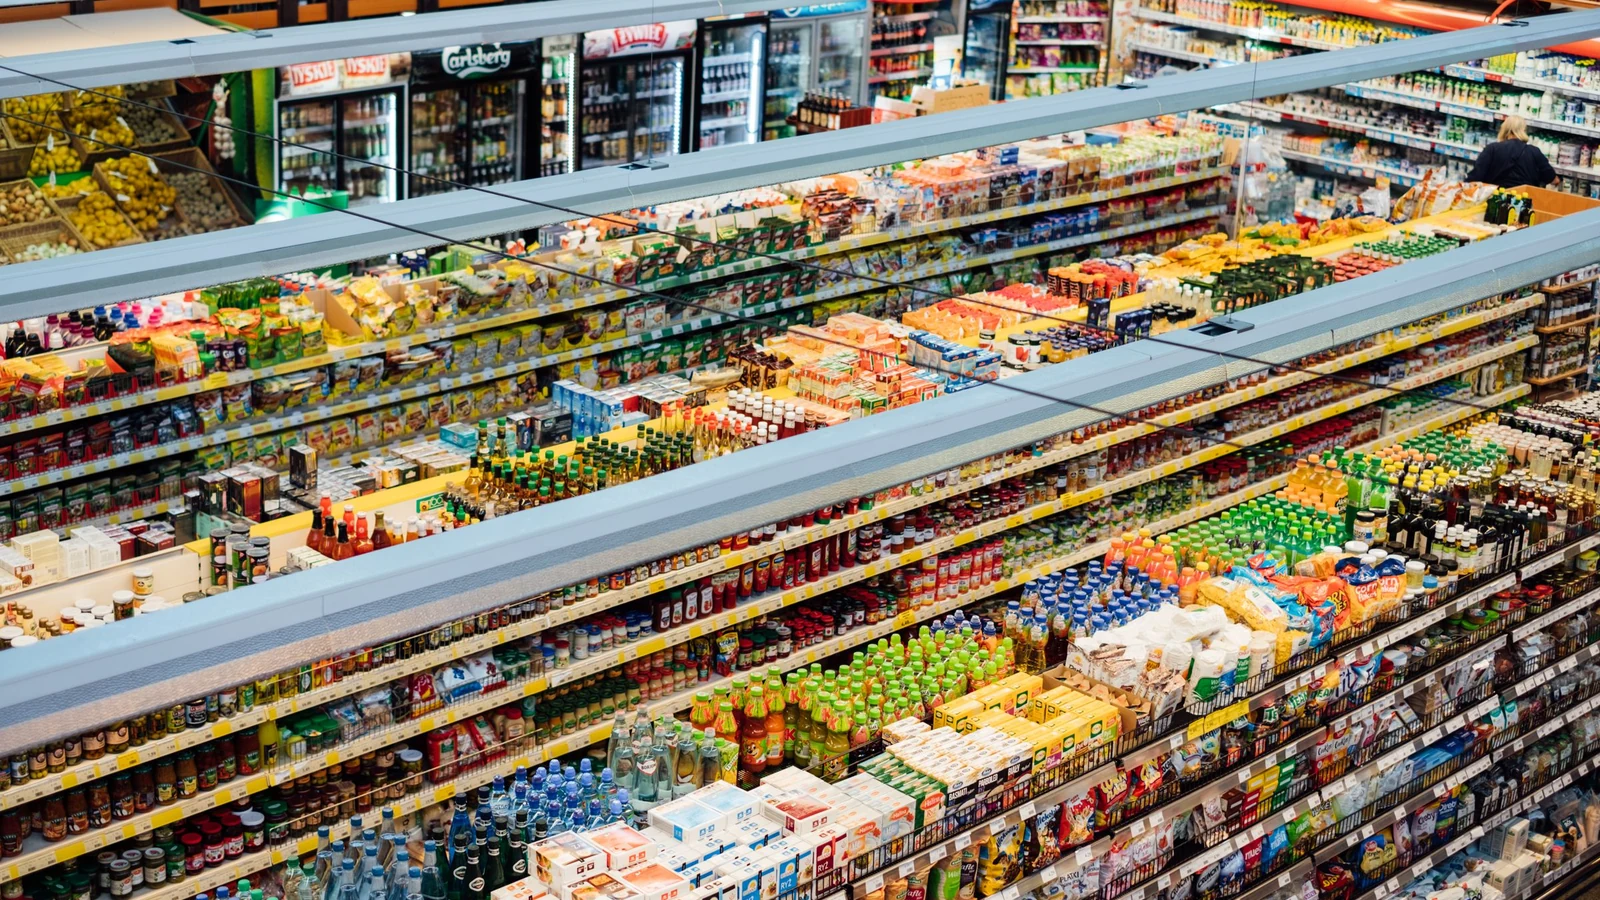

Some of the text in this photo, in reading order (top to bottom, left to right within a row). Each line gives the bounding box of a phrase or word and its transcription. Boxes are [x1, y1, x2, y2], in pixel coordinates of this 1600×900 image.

[441, 44, 511, 75] Carlsberg
[291, 61, 335, 86] TYSKIE
[1355, 581, 1378, 595] corn
[1379, 577, 1398, 586] orn
[785, 727, 796, 742] K
